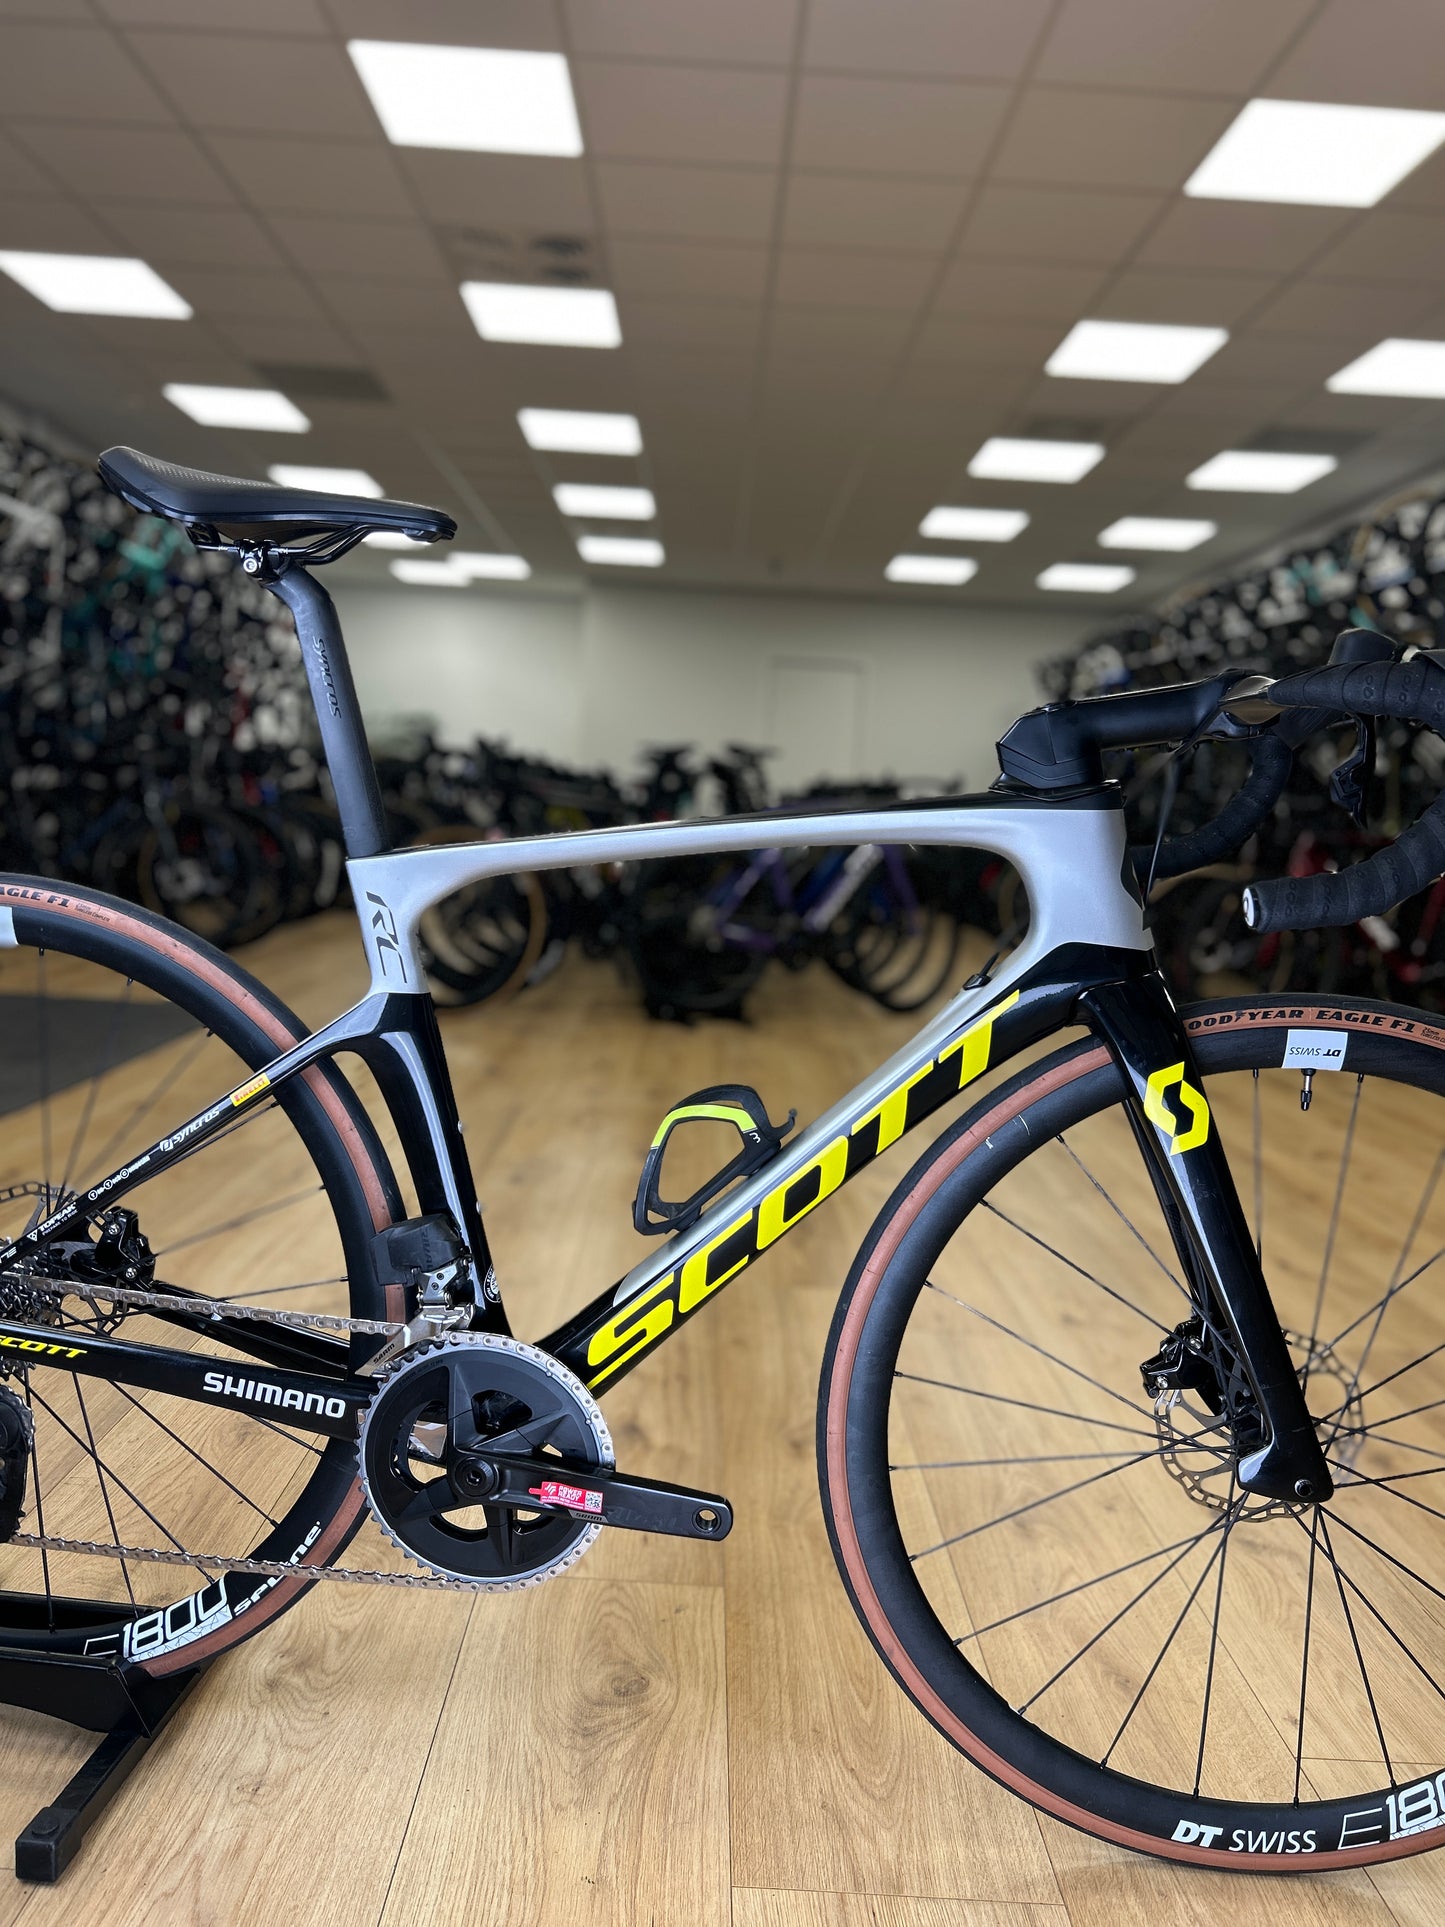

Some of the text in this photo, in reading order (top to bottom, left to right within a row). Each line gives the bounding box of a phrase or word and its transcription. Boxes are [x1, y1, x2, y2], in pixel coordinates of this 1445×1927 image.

[1186, 1009, 1415, 1033] OODYEAR EAGLE F1
[1289, 1046, 1342, 1057] DT SWISS
[587, 989, 1019, 1391] SCOTT
[38, 1202, 76, 1232] TOPEAK
[203, 1371, 346, 1419] SHIMANO
[1171, 1820, 1223, 1848] DT
[1229, 1829, 1316, 1854] SWISS
